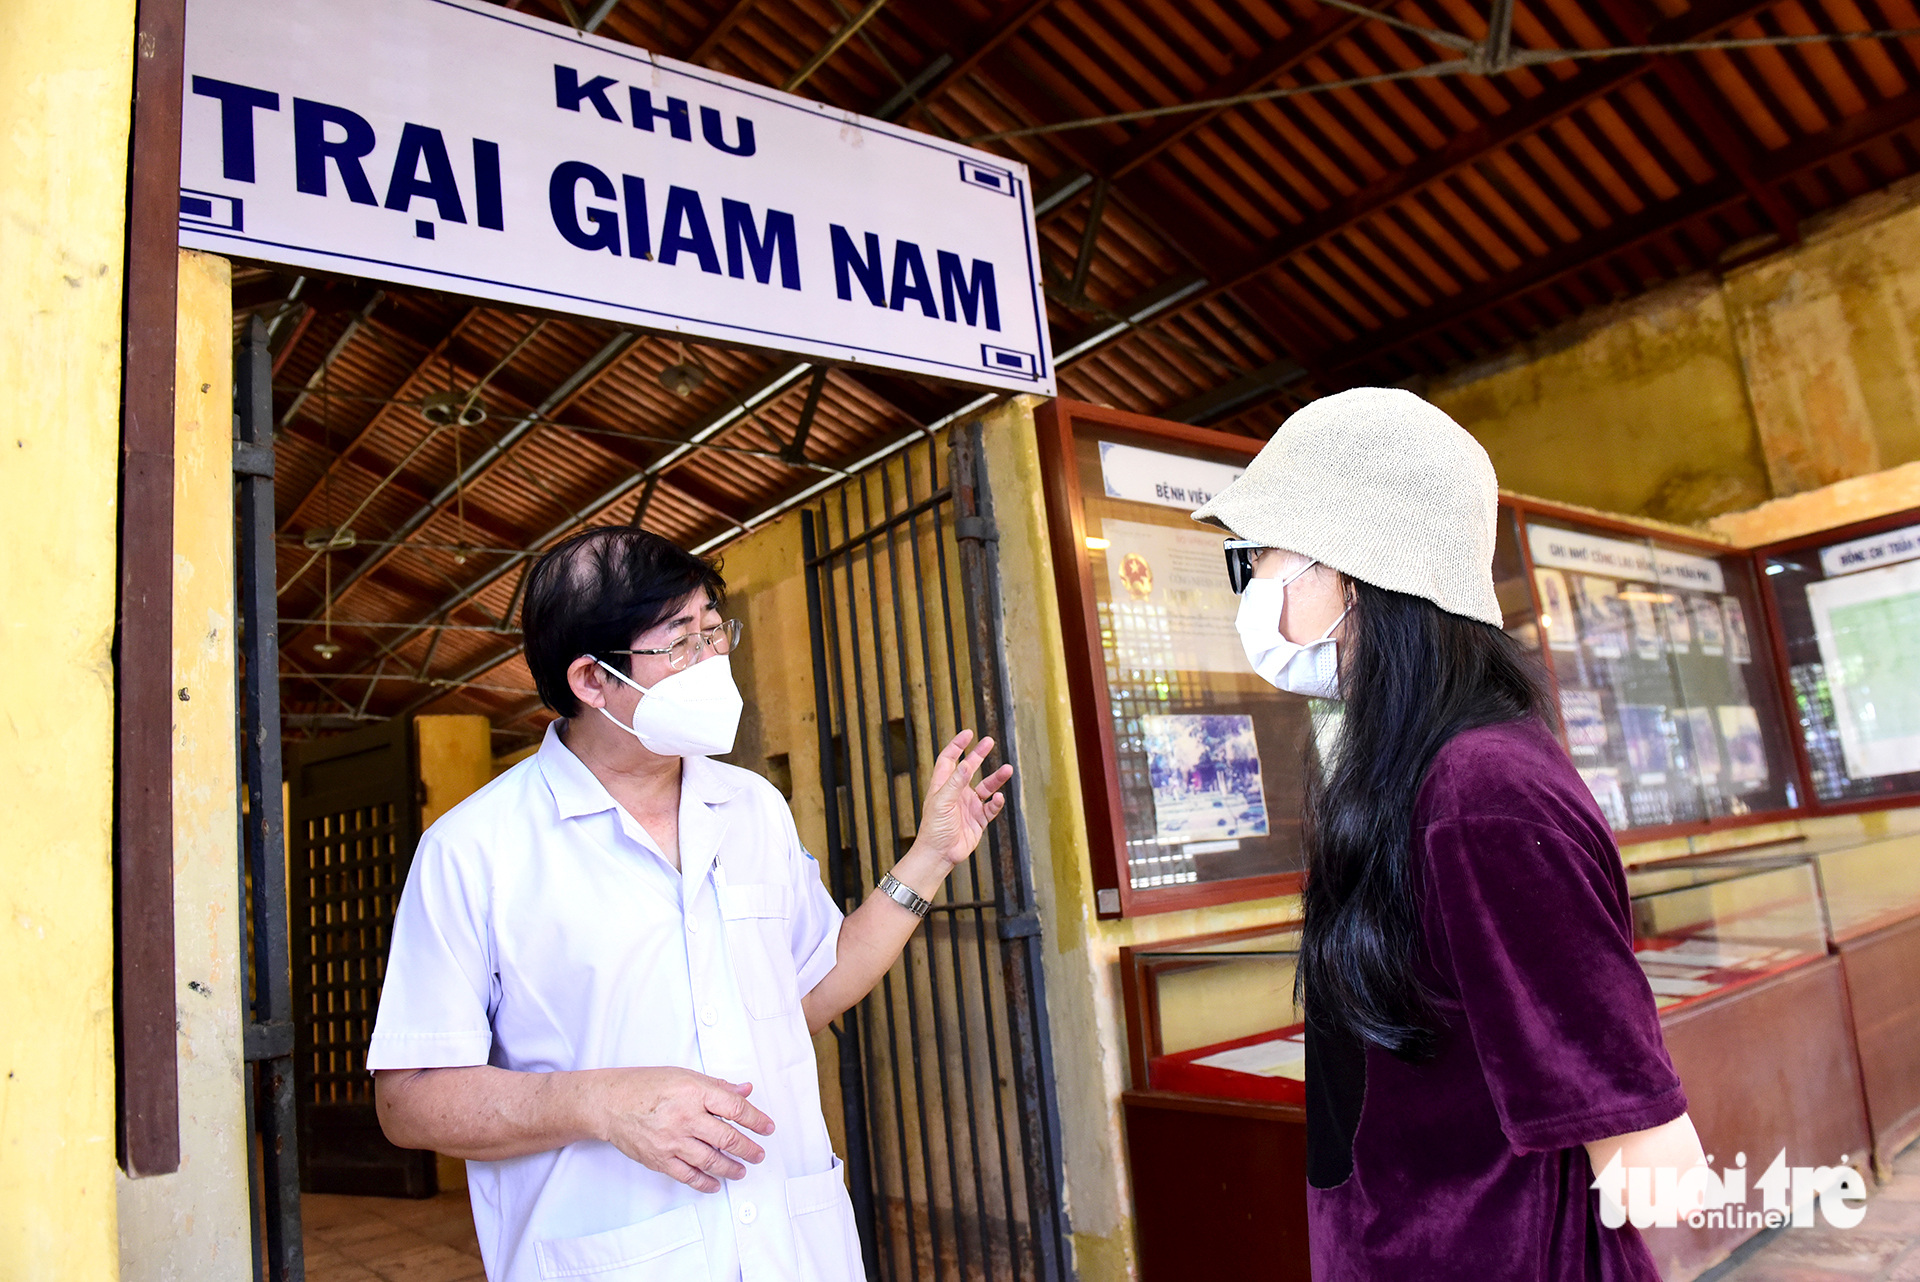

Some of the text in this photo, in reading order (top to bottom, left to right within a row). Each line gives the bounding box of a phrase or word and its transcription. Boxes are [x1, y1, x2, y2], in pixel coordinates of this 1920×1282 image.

[554, 64, 756, 157] KHU
[192, 75, 1001, 332] TRẠI GIAM NAM
[1155, 481, 1185, 502] BỆNH
